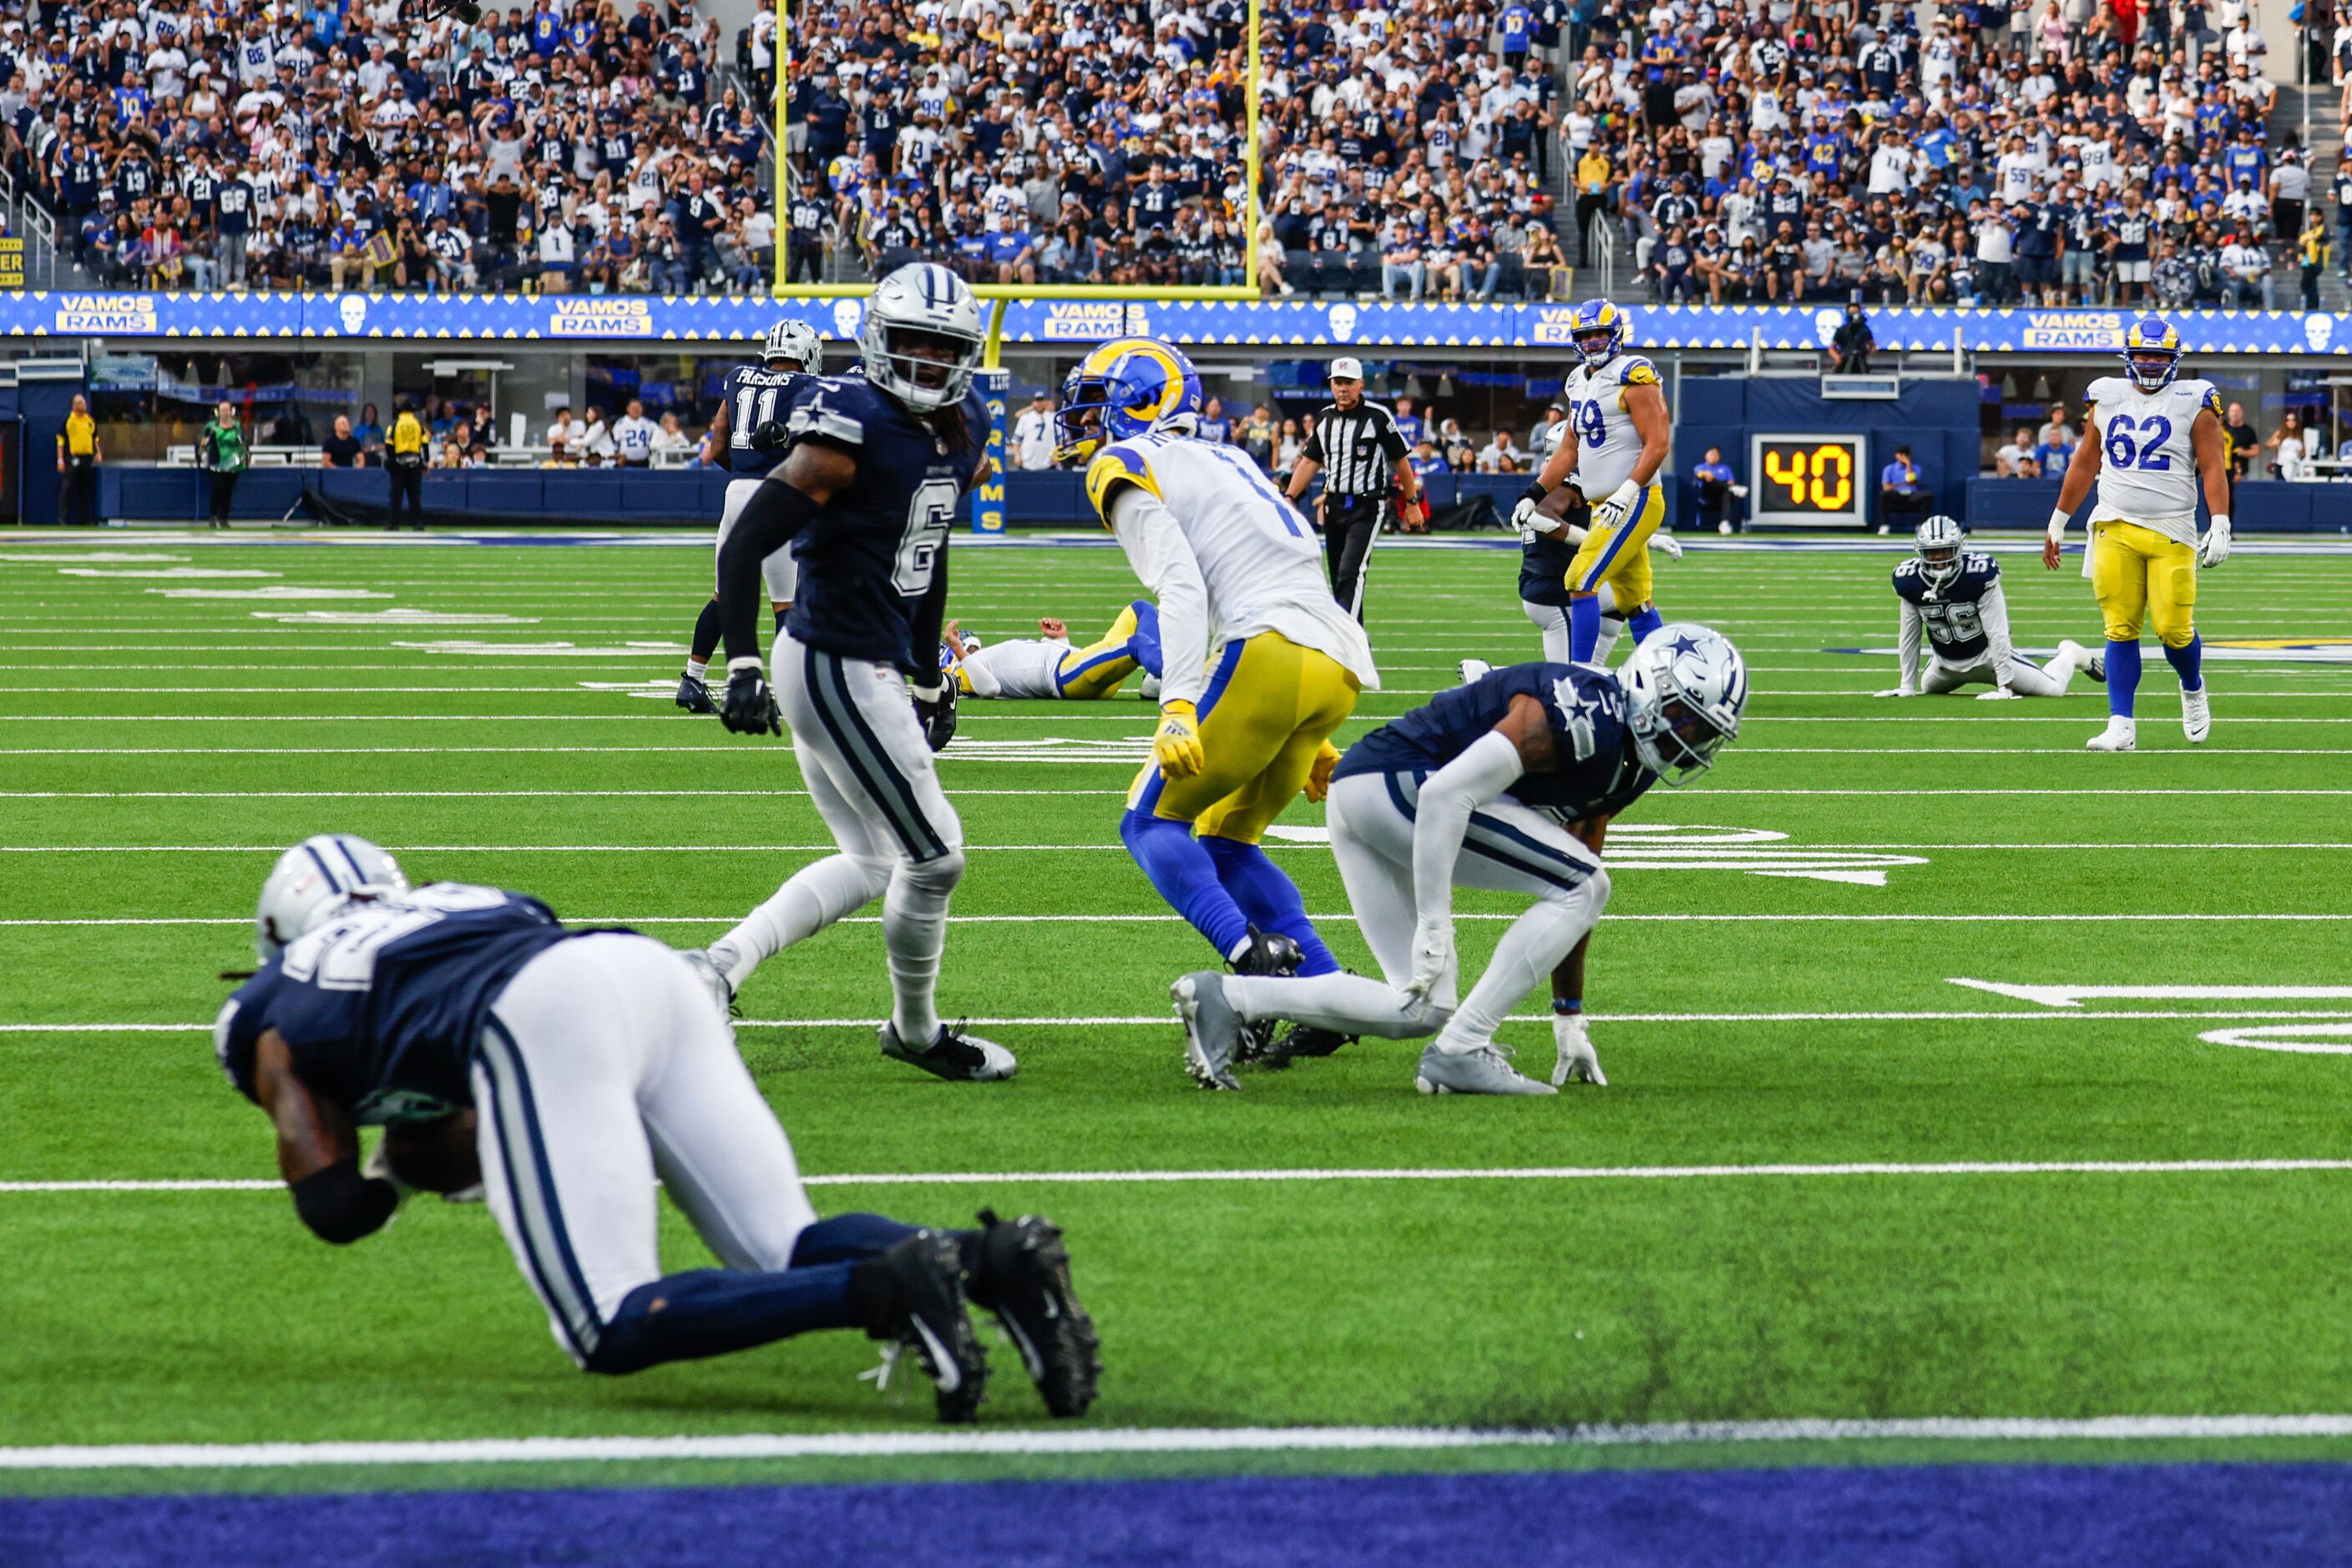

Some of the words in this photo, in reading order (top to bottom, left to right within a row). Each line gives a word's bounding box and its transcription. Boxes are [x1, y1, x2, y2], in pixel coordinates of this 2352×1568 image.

[539, 18, 551, 38] 9
[1505, 17, 1524, 35] 10
[574, 28, 585, 43] 9
[1930, 45, 1953, 61] 73
[1874, 53, 1891, 73] 21
[678, 74, 695, 92] 11
[121, 98, 139, 115] 10
[920, 99, 942, 118] 99
[1433, 131, 1451, 147] 21
[543, 143, 563, 160] 12
[1813, 144, 1835, 160] 42
[2081, 151, 2105, 165] 88
[1887, 156, 1900, 170] 11
[126, 171, 146, 192] 13
[642, 172, 656, 186] 21
[2011, 169, 2026, 184] 55
[194, 179, 212, 200] 21
[689, 198, 704, 218] 9
[1146, 192, 1163, 212] 11
[1773, 197, 1798, 214] 22
[2037, 210, 2051, 232] 7
[1323, 231, 1336, 251] 8
[2119, 222, 2146, 244] 82
[438, 237, 459, 257] 31
[554, 235, 562, 251] 1
[2242, 255, 2254, 266] 11
[60, 296, 154, 312] VAMOS
[555, 300, 649, 315] VAMOS
[1049, 303, 1146, 319] VAMOS
[67, 315, 146, 328] RAMS
[1539, 309, 1631, 322] VAS
[2029, 314, 2122, 328] VAMOS
[561, 319, 641, 331] RAMS
[1055, 322, 1138, 336] RAMS
[2034, 332, 2113, 346] RAMS
[736, 369, 795, 387] PARSONS
[731, 387, 777, 449] 11
[1571, 399, 1606, 448] 79
[625, 429, 648, 448] 24
[1034, 424, 1046, 441] 7
[2106, 414, 2172, 471] 62
[1765, 445, 1851, 510] 40
[891, 478, 959, 597] 6
[1920, 602, 1984, 645] 56
